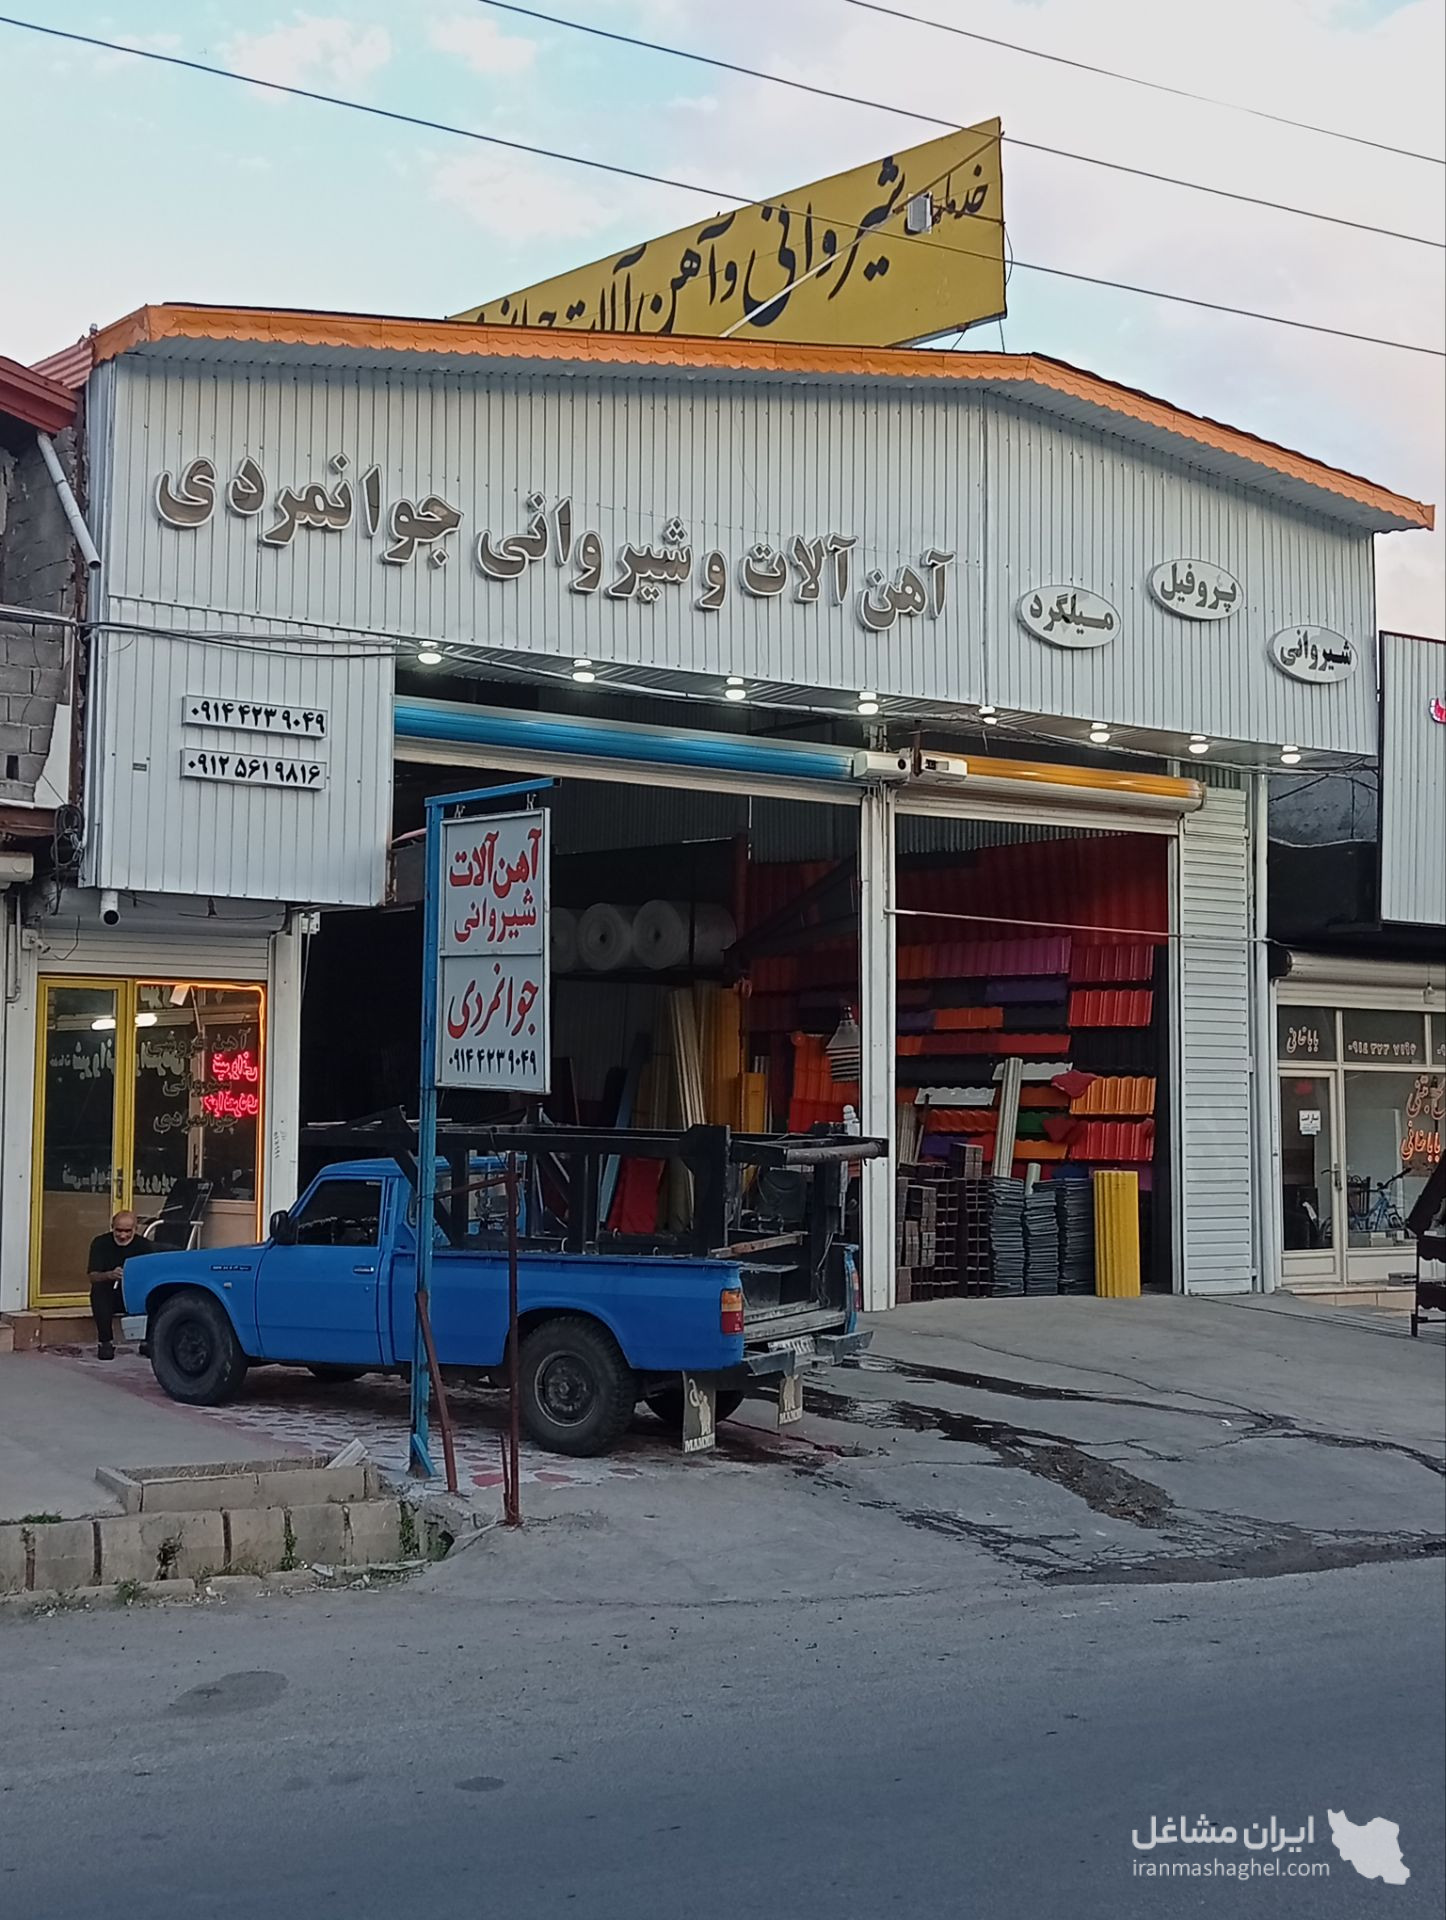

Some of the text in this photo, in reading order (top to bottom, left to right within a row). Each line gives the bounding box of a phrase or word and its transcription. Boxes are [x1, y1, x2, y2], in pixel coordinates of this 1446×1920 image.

[903, 163, 989, 236] خدما
[743, 156, 906, 328] شیروانی
[155, 452, 956, 632] آهن آلات و شیروانی جوانمردی
[1029, 591, 1115, 634] میلگرد
[1159, 562, 1238, 613] پروفیل
[1280, 629, 1354, 673] شیروانی
[191, 700, 325, 734] ۰۹۱۴ ۴۲۳ ۹۰۴۹
[188, 753, 320, 784] ۰۹۱۲ ۵۶۱ ۹۸۱۶
[449, 828, 542, 898] آهن آلات
[454, 888, 537, 942] شیروانی
[447, 962, 539, 1039] جوانمردی
